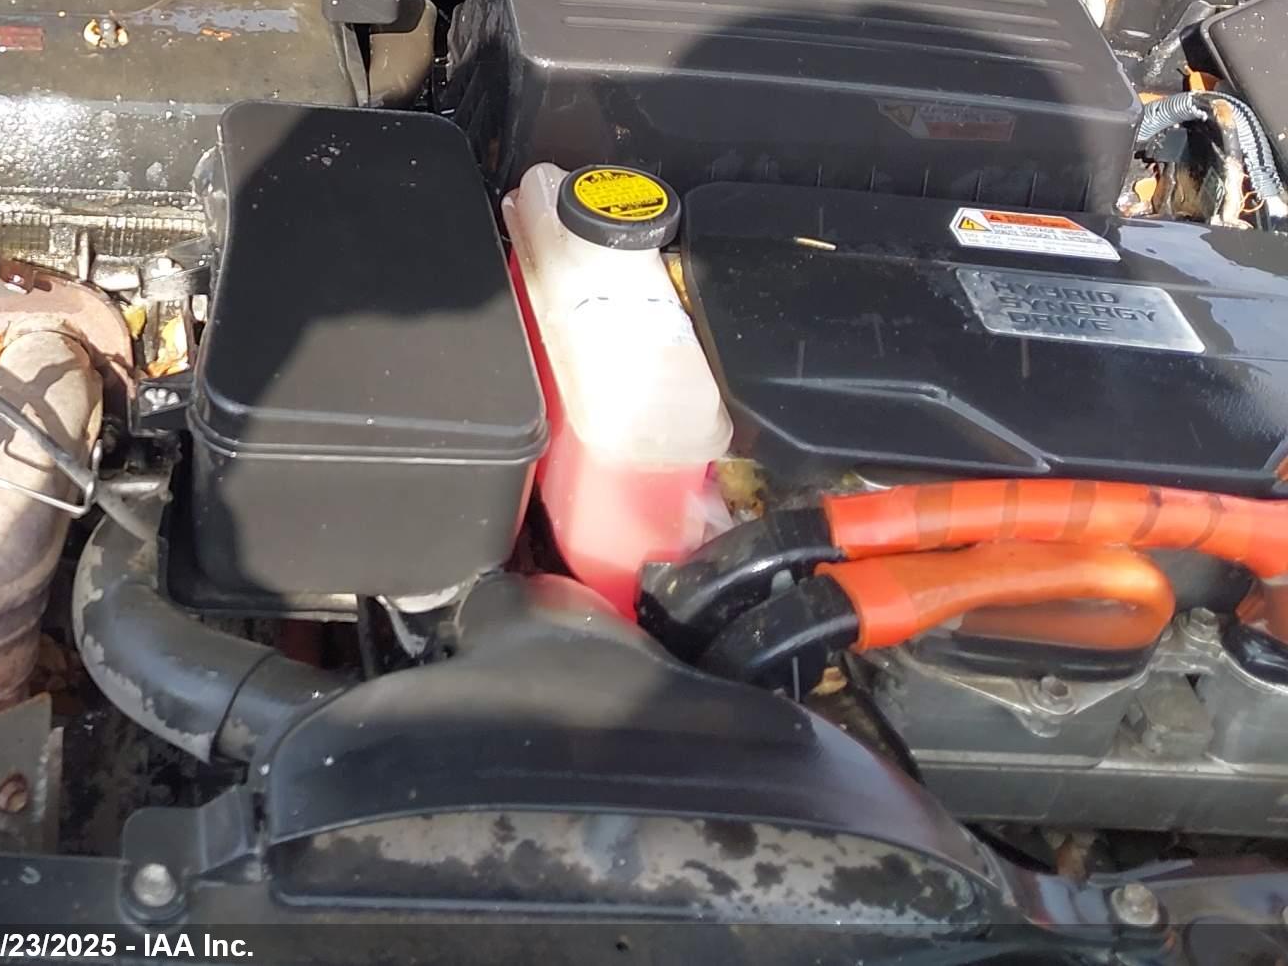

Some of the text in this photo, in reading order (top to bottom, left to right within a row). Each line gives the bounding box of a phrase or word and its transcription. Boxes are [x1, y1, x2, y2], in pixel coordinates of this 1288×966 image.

[989, 279, 1120, 305] HYBRID
[998, 295, 1157, 322] SYNERGY
[1007, 310, 1114, 331] DRIVE
